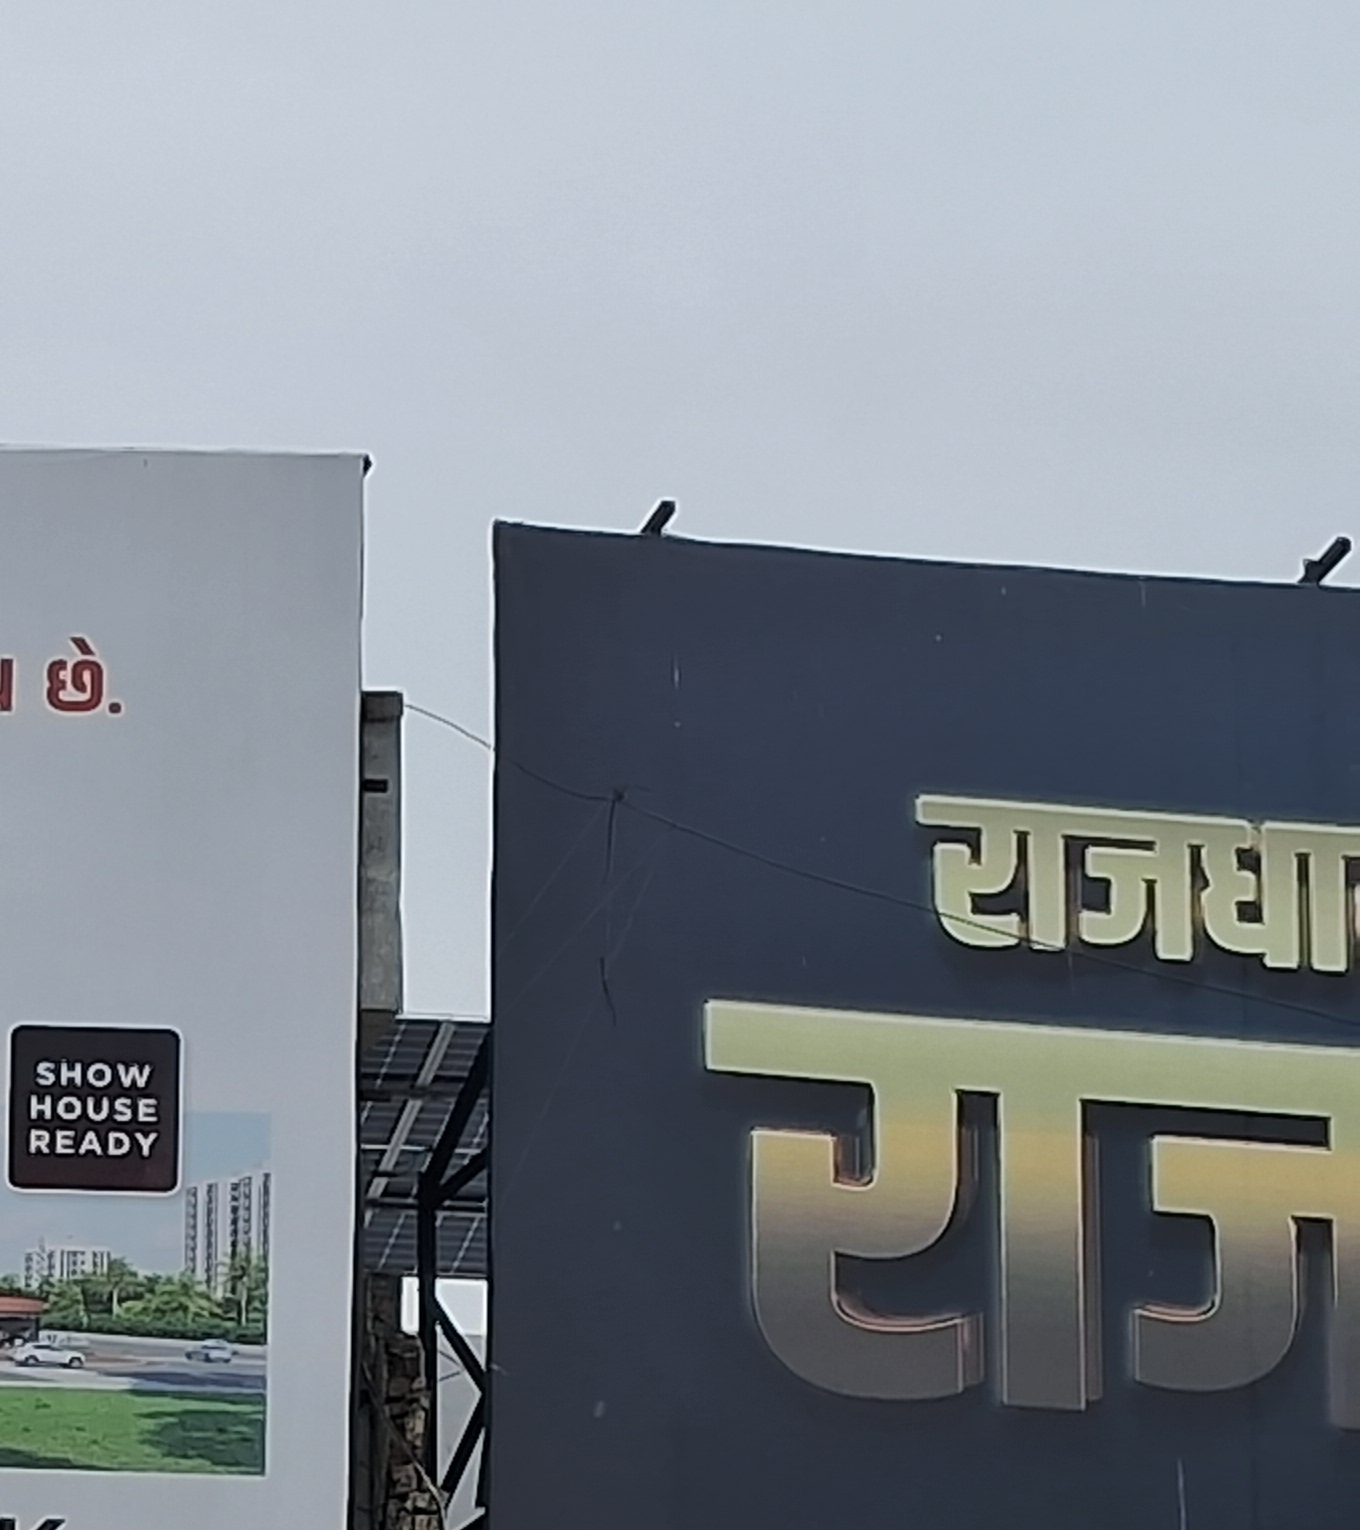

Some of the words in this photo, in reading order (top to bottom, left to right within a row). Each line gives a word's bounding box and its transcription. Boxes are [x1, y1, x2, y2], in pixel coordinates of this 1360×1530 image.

[46, 636, 122, 714] છે.
[915, 794, 1360, 974] राजधा
[36, 1060, 151, 1088] SHOW
[30, 1095, 158, 1121] HOUSE
[30, 1129, 158, 1157] READY
